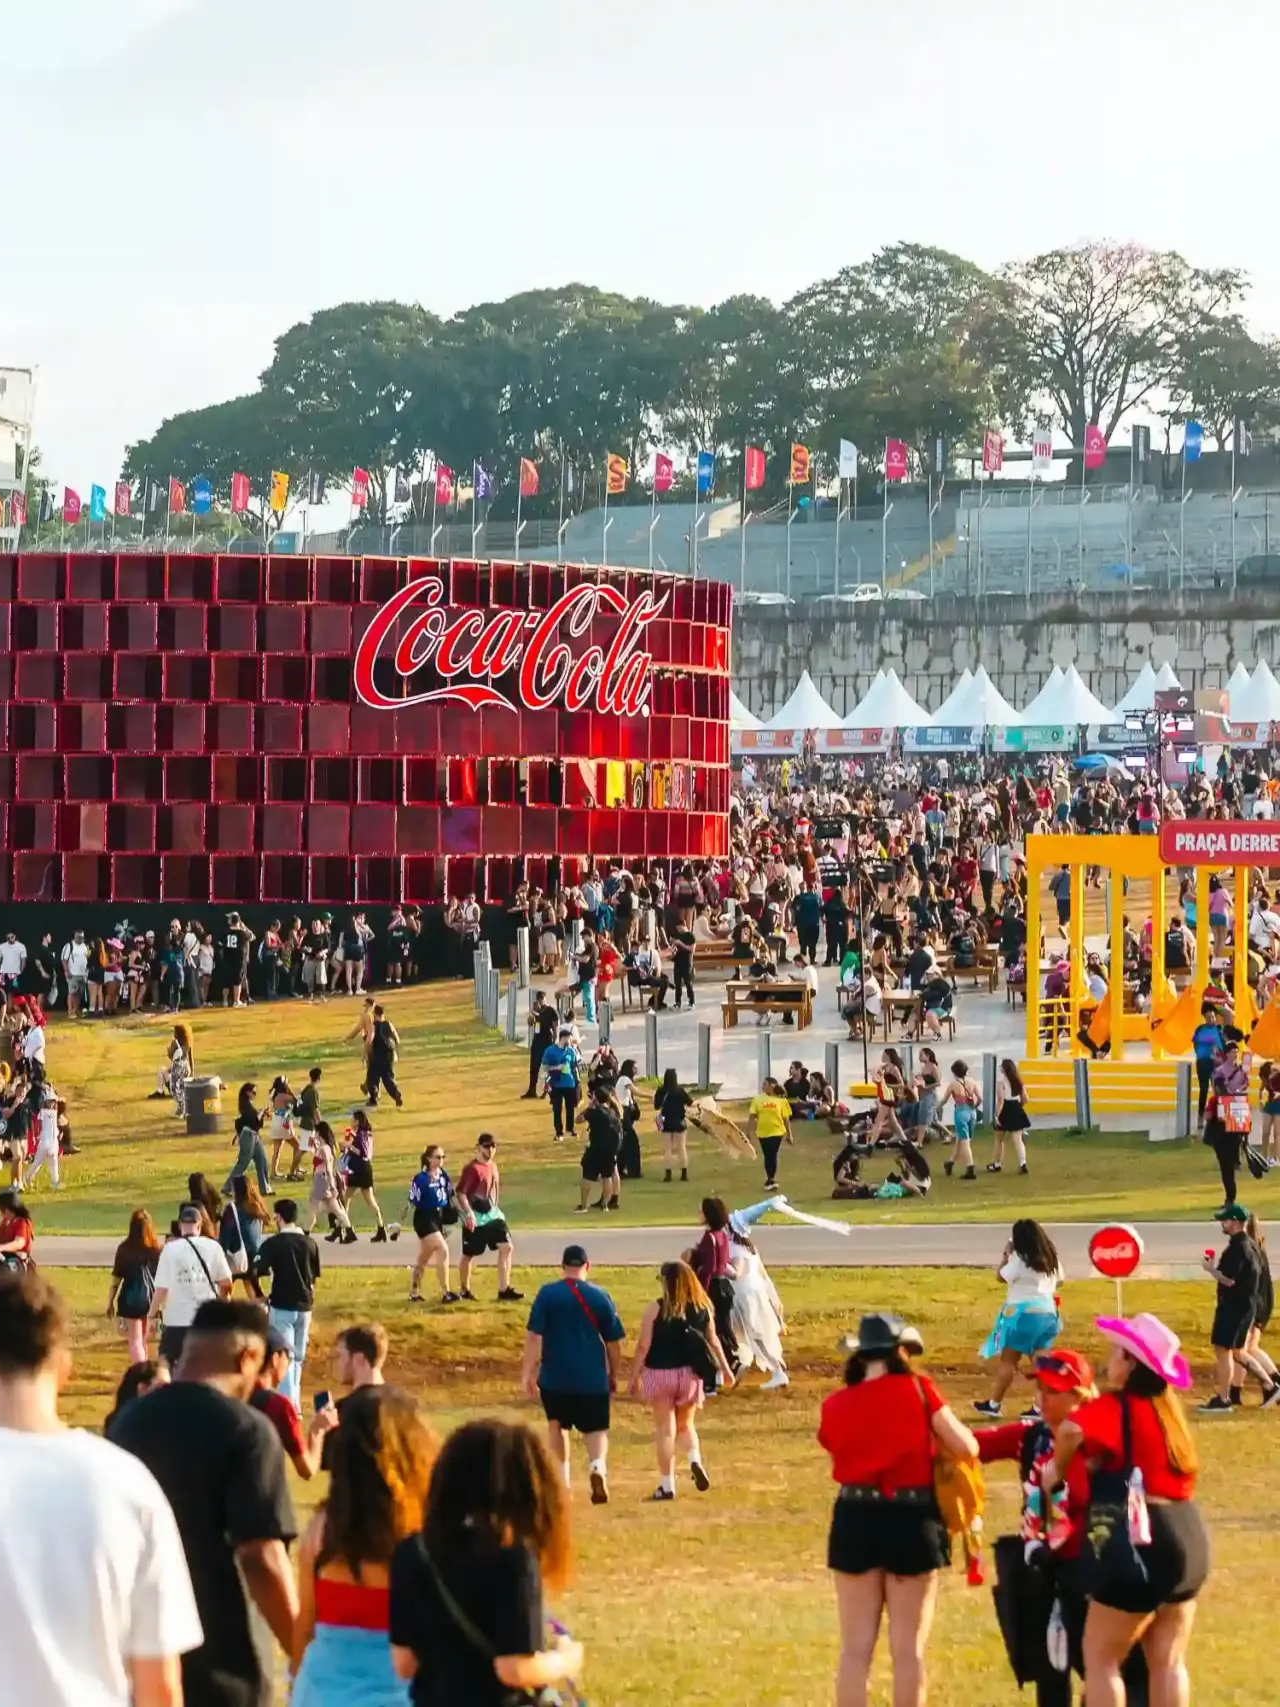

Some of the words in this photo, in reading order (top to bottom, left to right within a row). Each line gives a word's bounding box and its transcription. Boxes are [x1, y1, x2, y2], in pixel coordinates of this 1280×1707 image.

[354, 576, 670, 718] Coca-Cola
[1175, 833, 1228, 857] PRAÇA
[1230, 833, 1280, 852] DERRE
